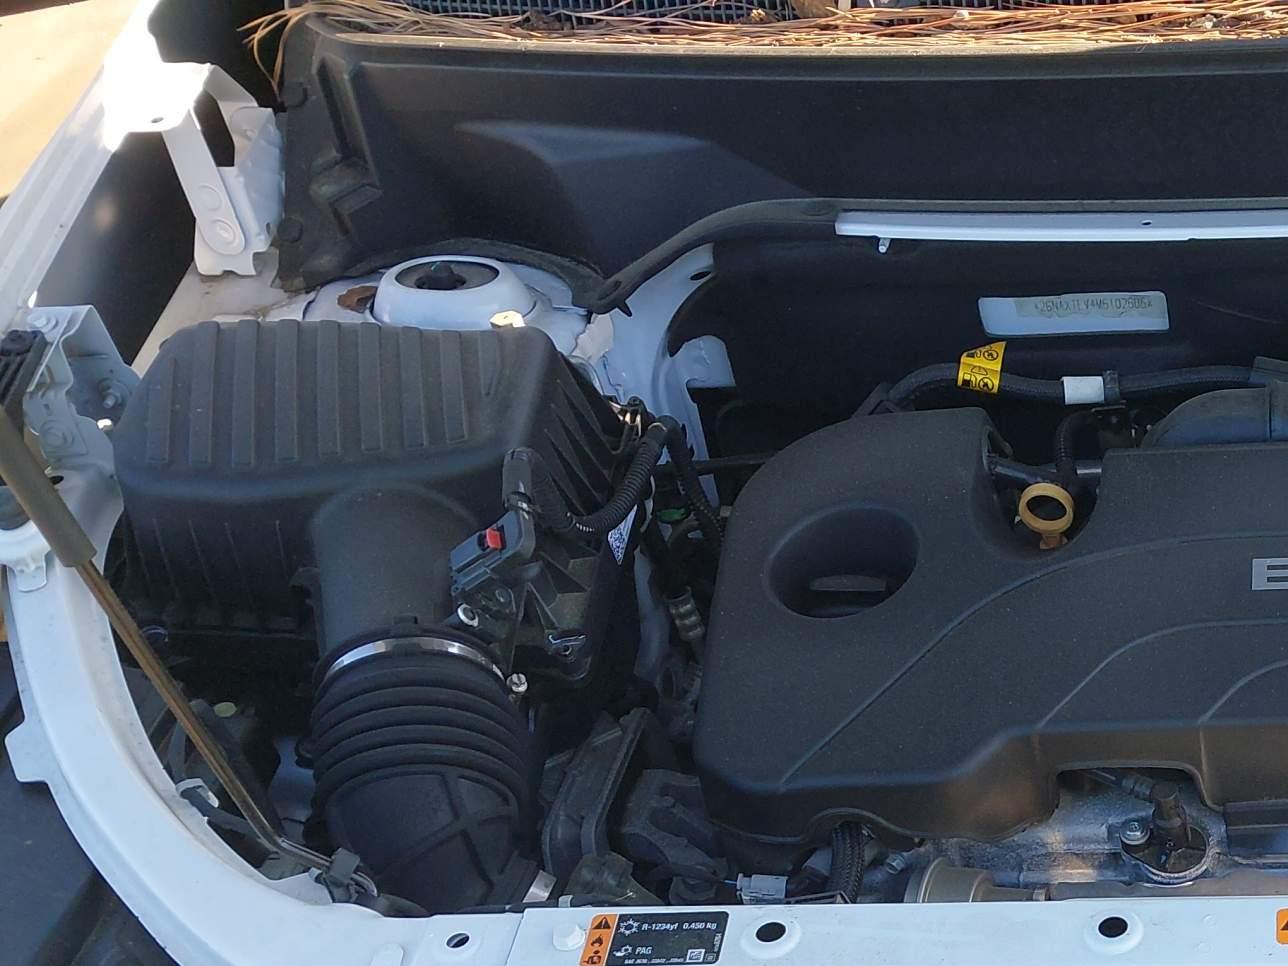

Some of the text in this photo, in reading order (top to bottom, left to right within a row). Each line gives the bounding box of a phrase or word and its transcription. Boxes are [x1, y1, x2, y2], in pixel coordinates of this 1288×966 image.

[641, 922, 678, 931] R-1234yf
[706, 922, 717, 931] kg
[635, 946, 652, 954] PAG
